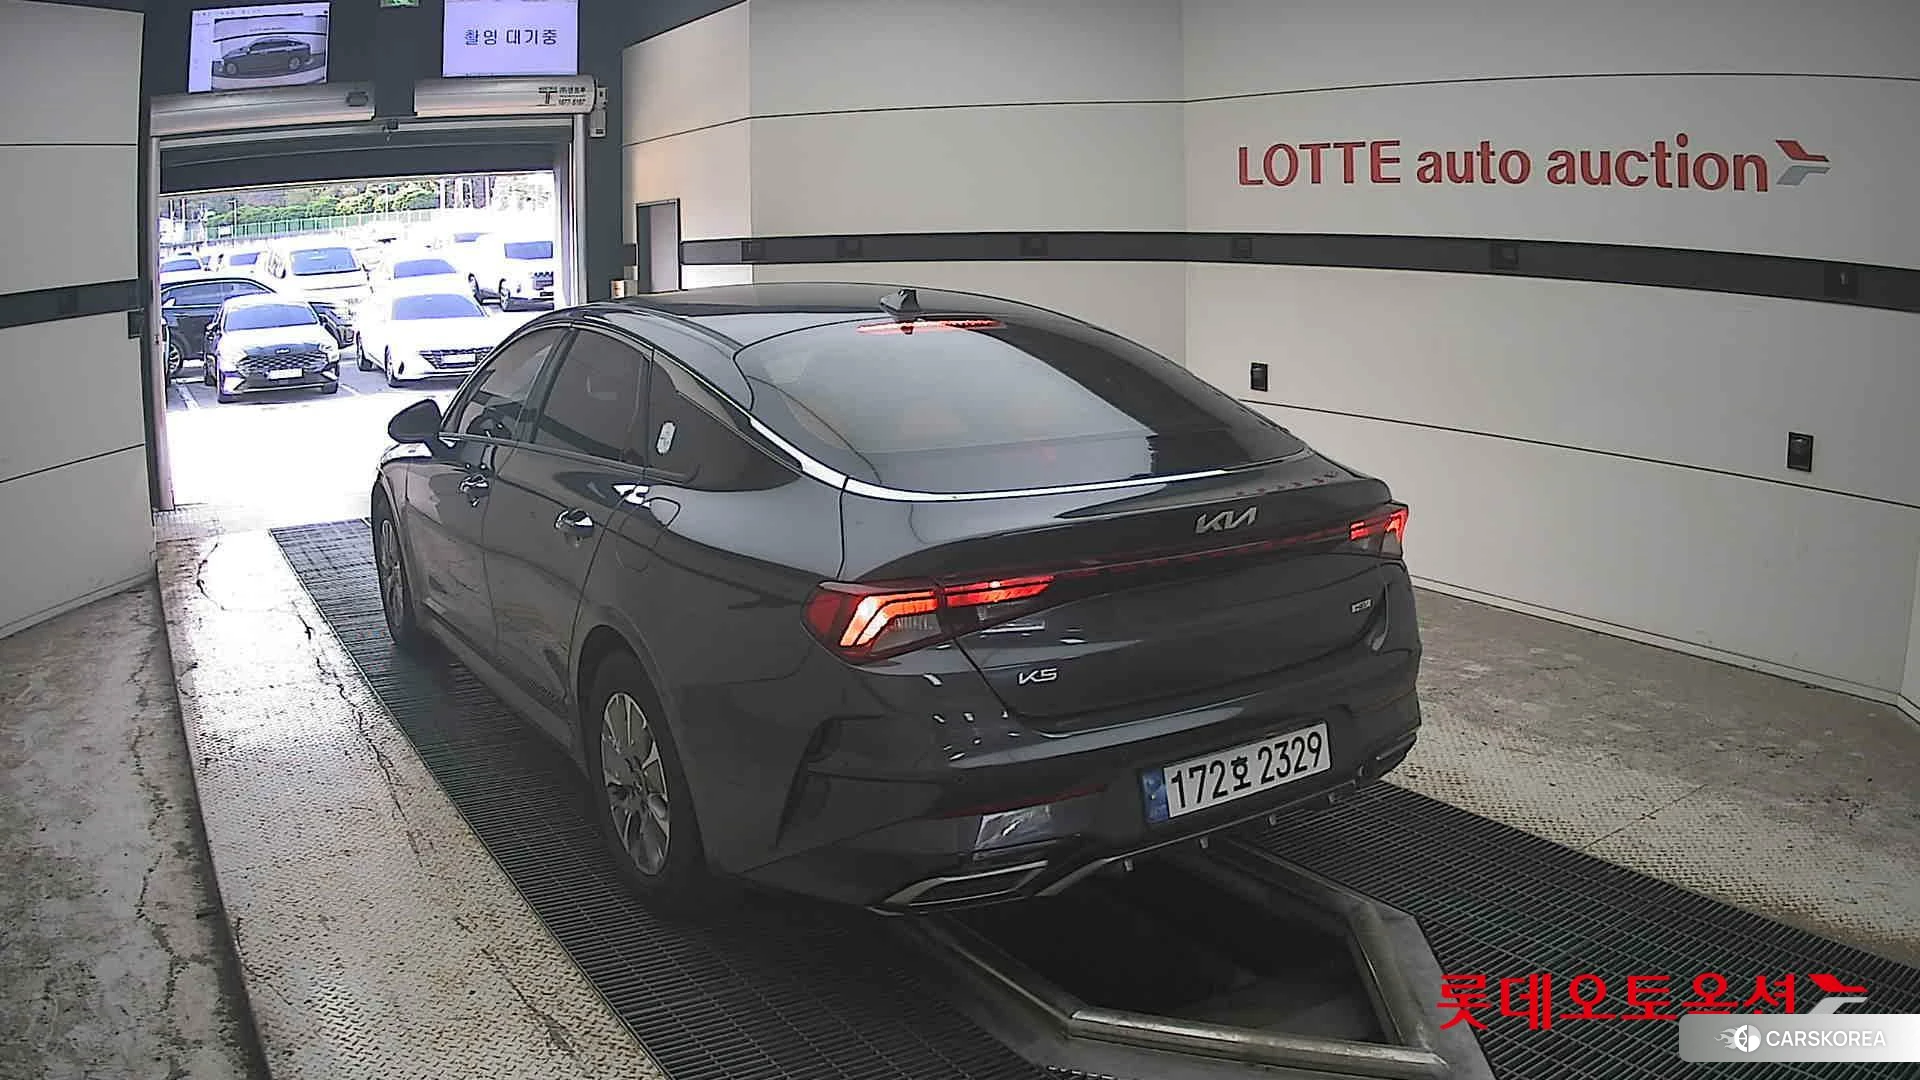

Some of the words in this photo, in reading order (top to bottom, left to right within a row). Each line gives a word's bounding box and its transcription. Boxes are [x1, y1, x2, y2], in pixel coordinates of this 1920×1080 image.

[506, 28, 558, 45] 대기중
[1238, 140, 1402, 186] LOTTE
[1416, 140, 1531, 184] auto
[1547, 132, 1769, 192] auction
[1196, 506, 1257, 534] KIA
[1018, 668, 1058, 685] K5
[1170, 755, 1252, 809] 172호
[1257, 731, 1323, 785] 2329
